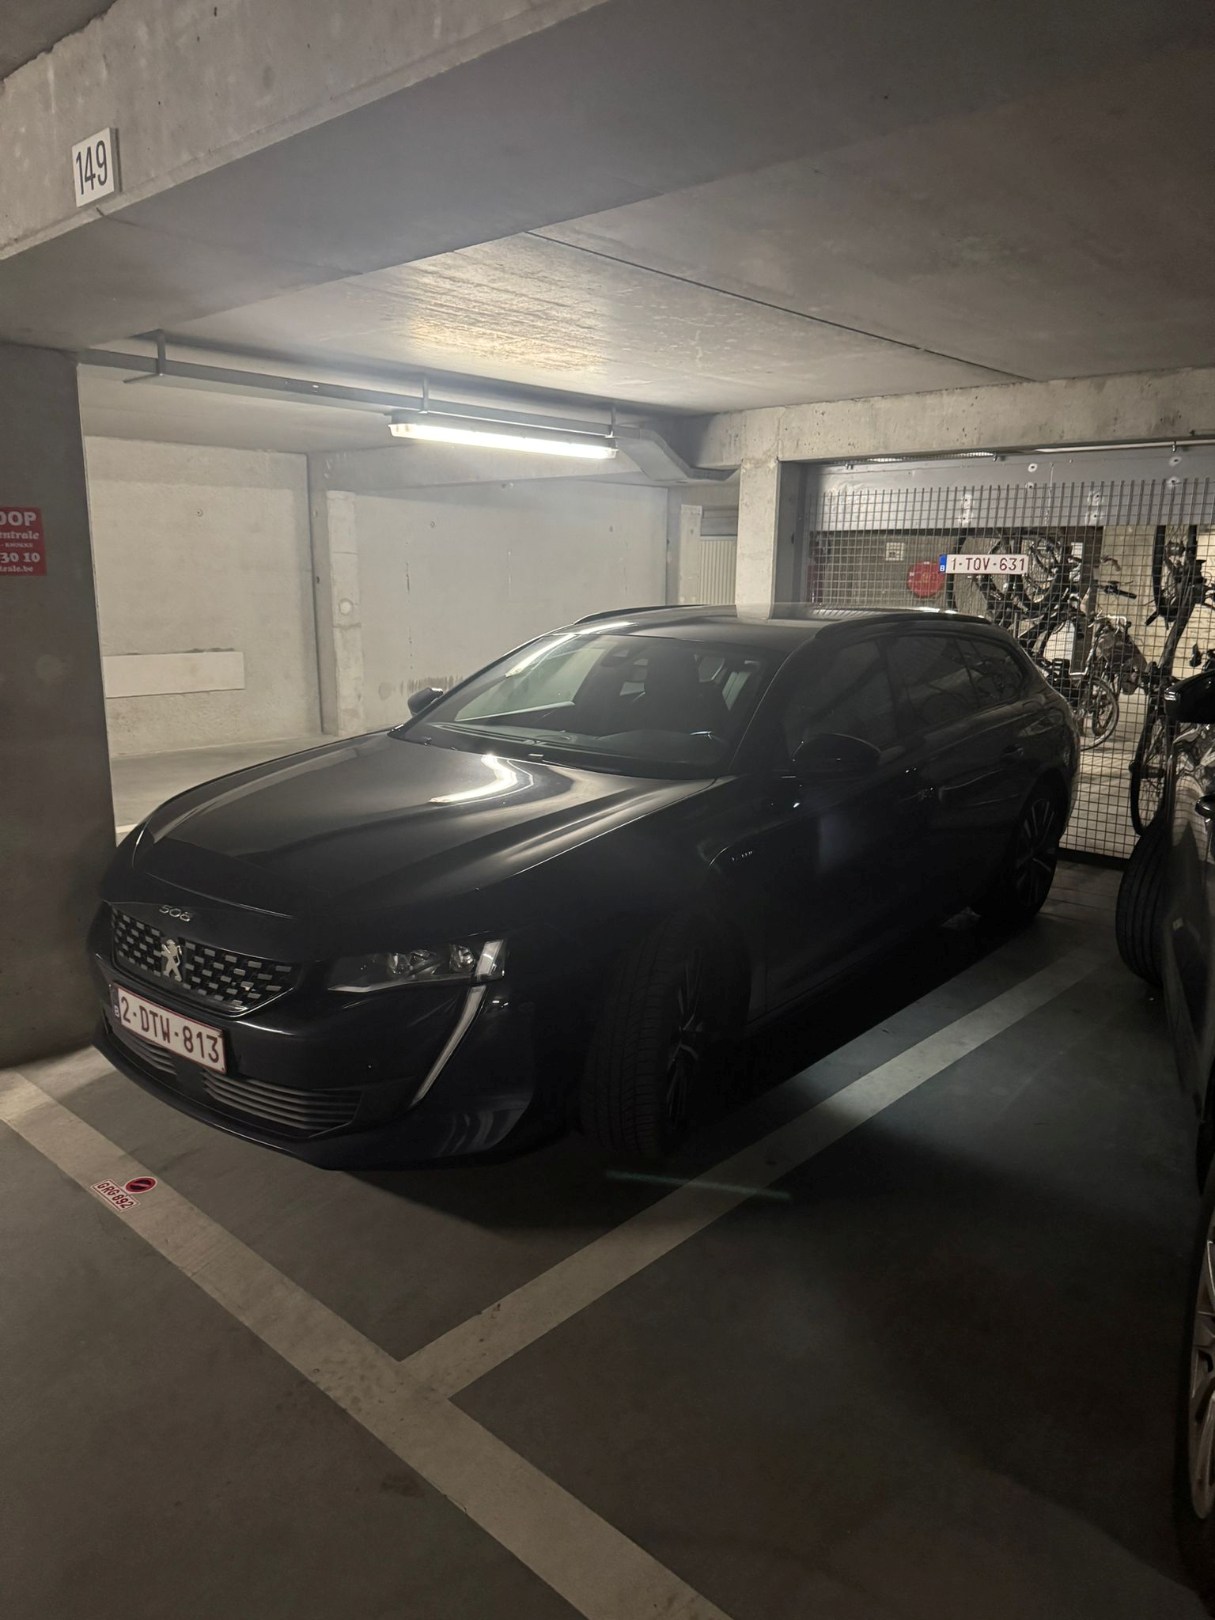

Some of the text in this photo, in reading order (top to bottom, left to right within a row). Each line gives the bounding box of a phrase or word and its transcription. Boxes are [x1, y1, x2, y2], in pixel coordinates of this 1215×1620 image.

[76, 140, 107, 195] 149
[23, 552, 40, 563] 10
[159, 904, 190, 922] 508
[121, 996, 219, 1063] 2-DTW-813
